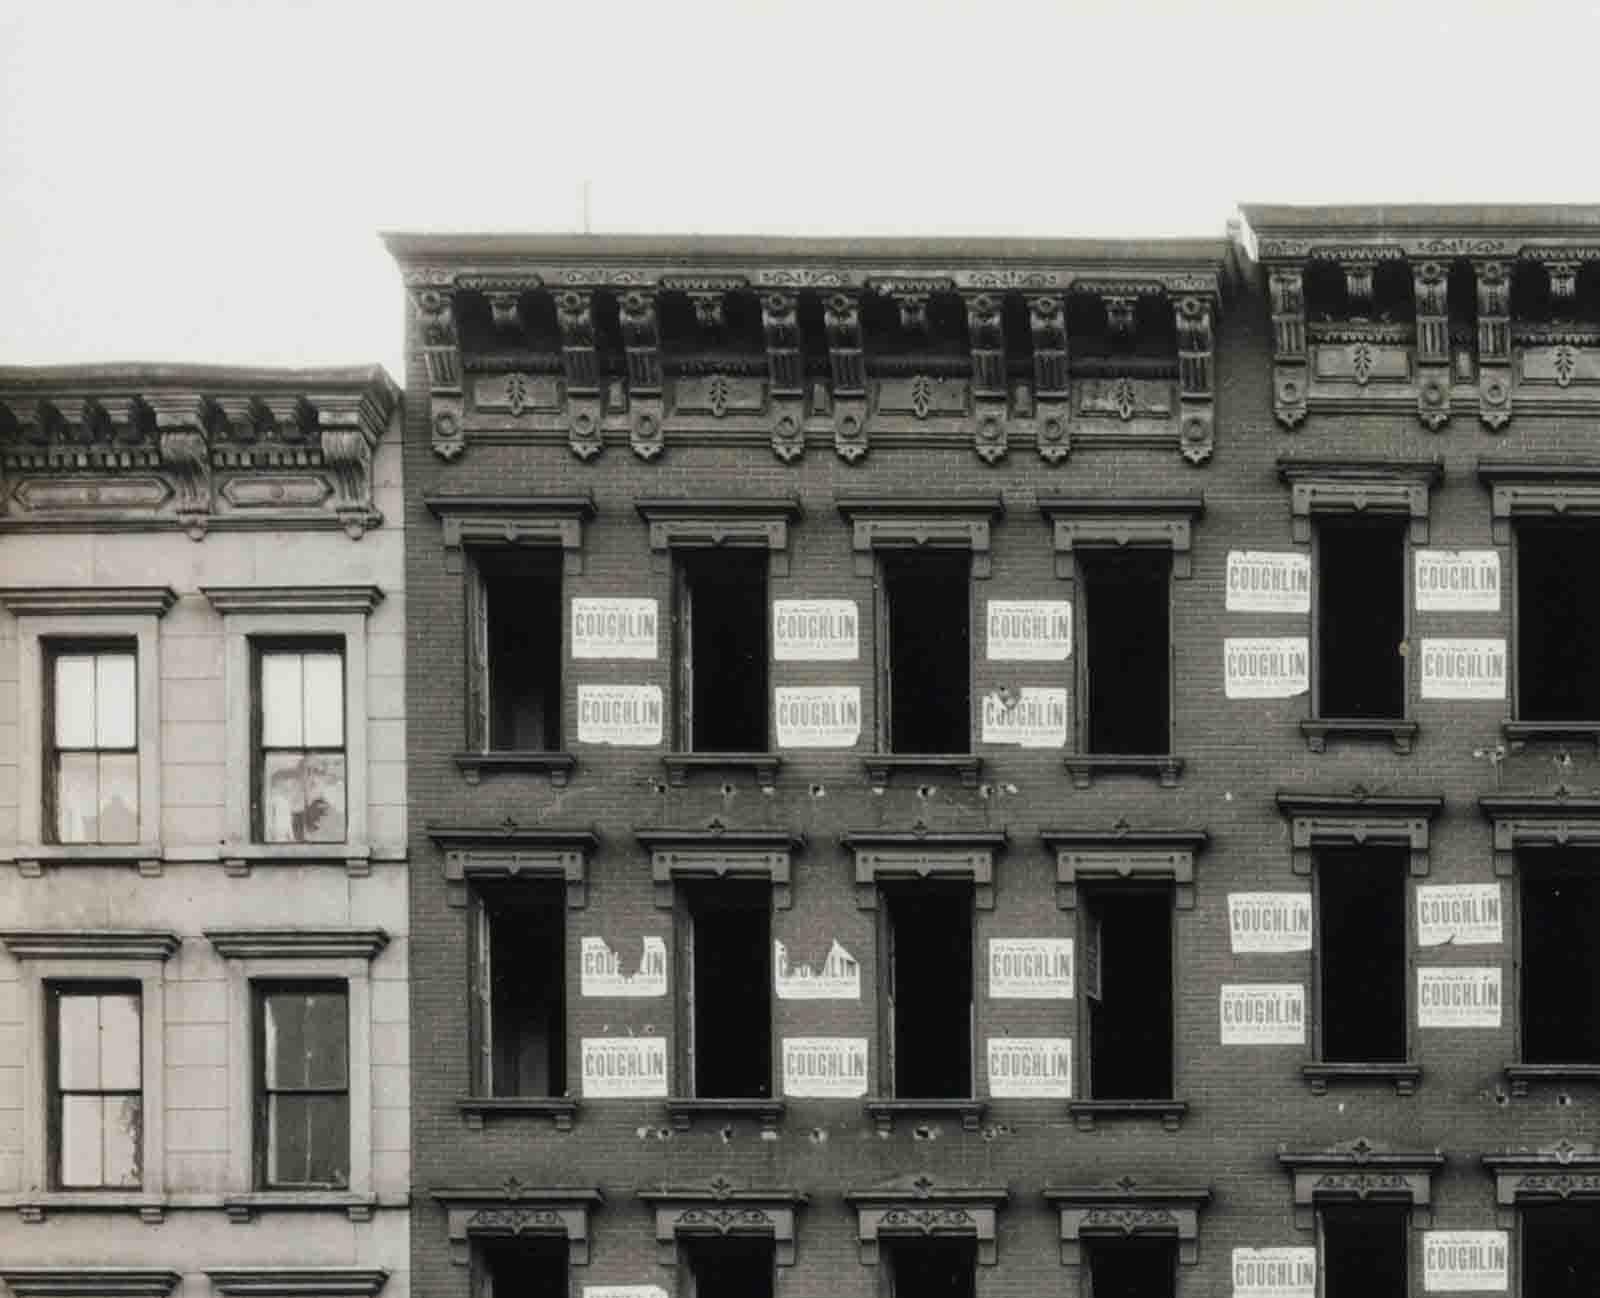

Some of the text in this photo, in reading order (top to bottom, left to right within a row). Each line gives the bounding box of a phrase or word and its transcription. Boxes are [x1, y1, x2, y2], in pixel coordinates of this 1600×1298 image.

[1418, 565, 1498, 589] COUGHLIN
[576, 613, 656, 637] COUGHLIN
[1227, 652, 1307, 676] COUGHLIN
[779, 701, 859, 725] COUGHLIN
[1420, 899, 1500, 923] COUGHLIN
[992, 953, 1072, 977] COUGHLIN
[786, 1052, 866, 1076] COUGHLIN
[1428, 1246, 1505, 1269] COUGHLIN
